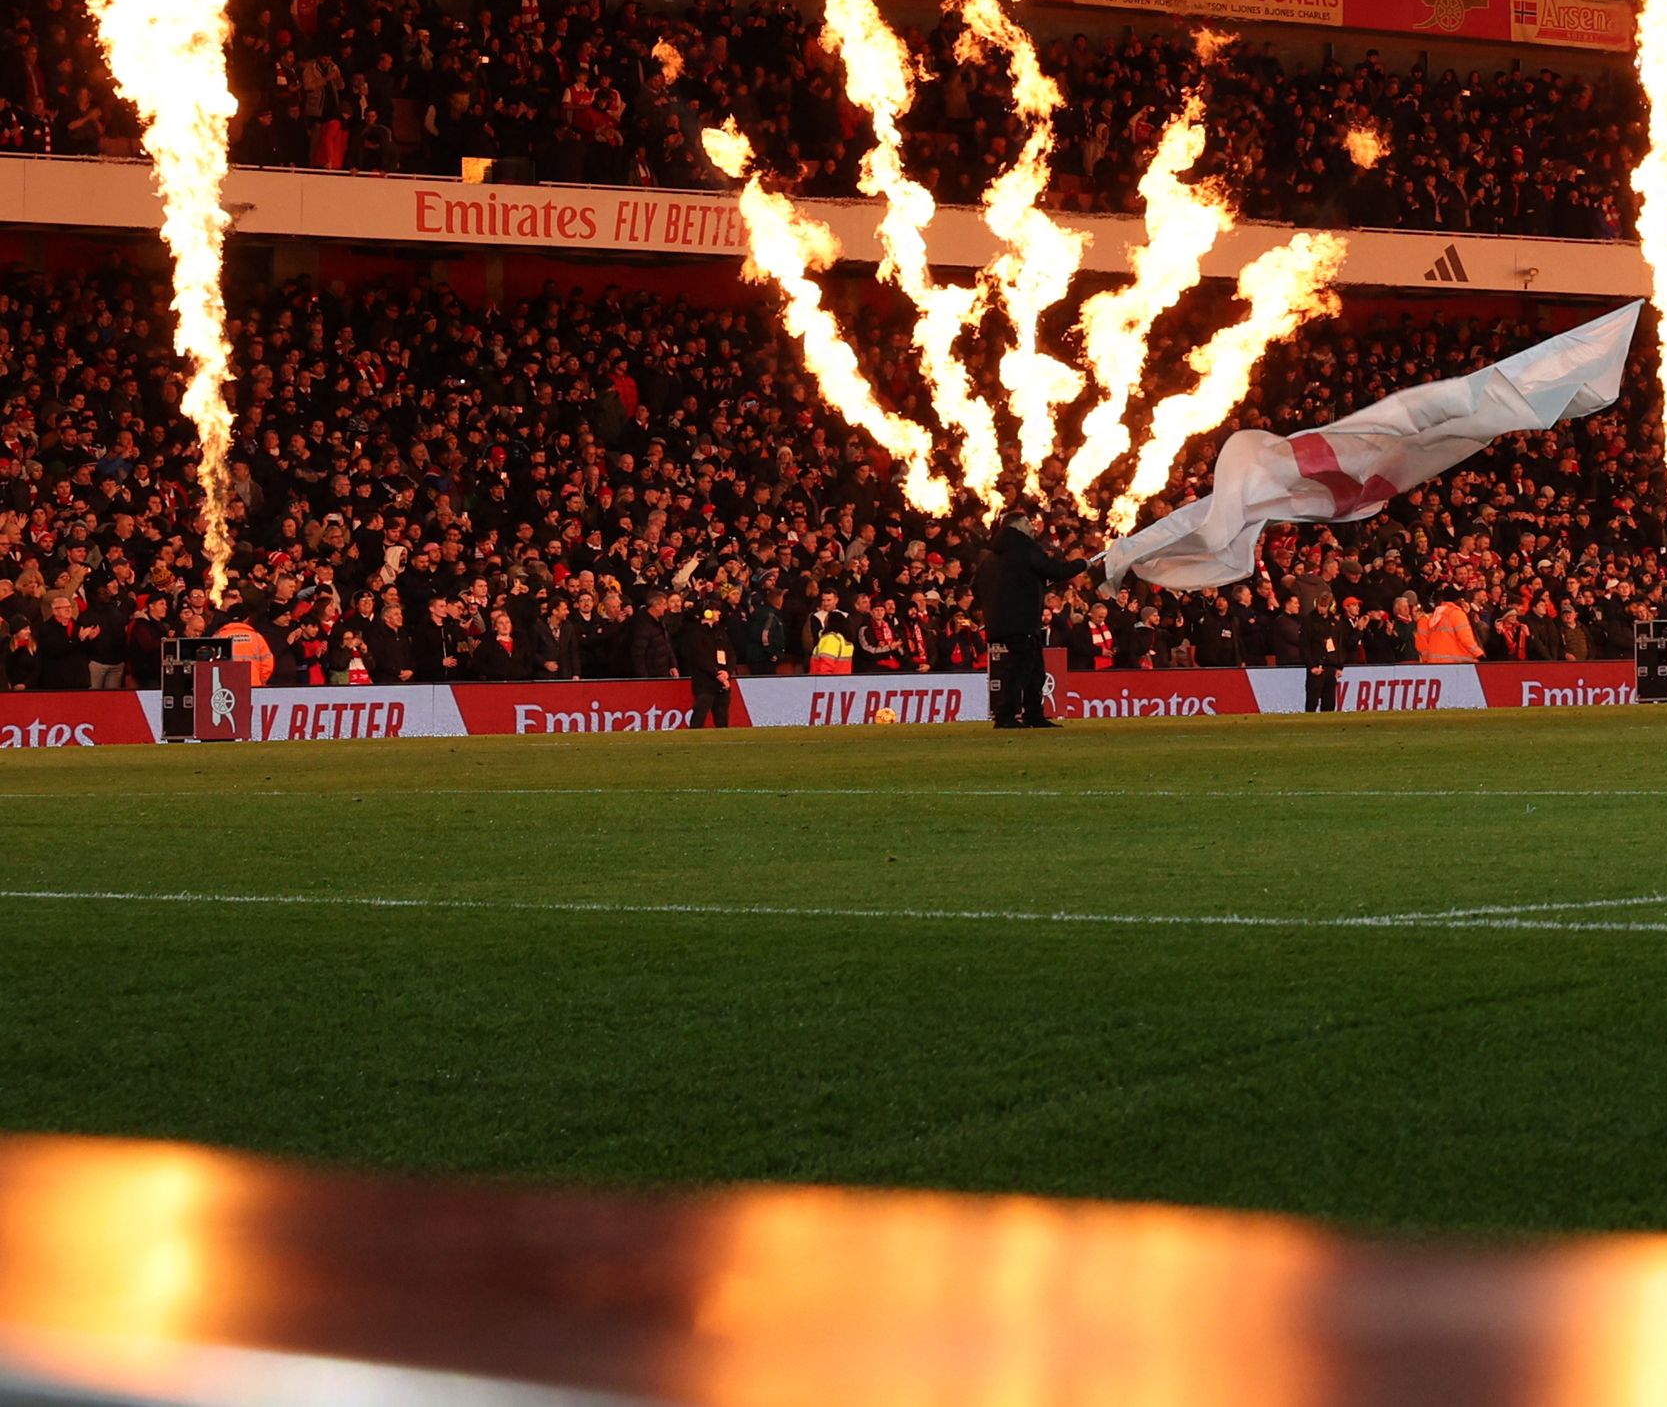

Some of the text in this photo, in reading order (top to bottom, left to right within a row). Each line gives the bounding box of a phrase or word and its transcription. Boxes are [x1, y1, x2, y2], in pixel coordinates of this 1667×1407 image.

[1298, 10, 1330, 20] CHARLES
[415, 190, 596, 240] Emirates
[614, 200, 657, 243] FLY
[811, 691, 855, 725] FLY
[1356, 678, 1442, 712] BETTER
[1520, 680, 1637, 707] Emirat
[1, 717, 96, 748] ates
[288, 702, 405, 741] BETTER
[514, 700, 694, 734] Emirate
